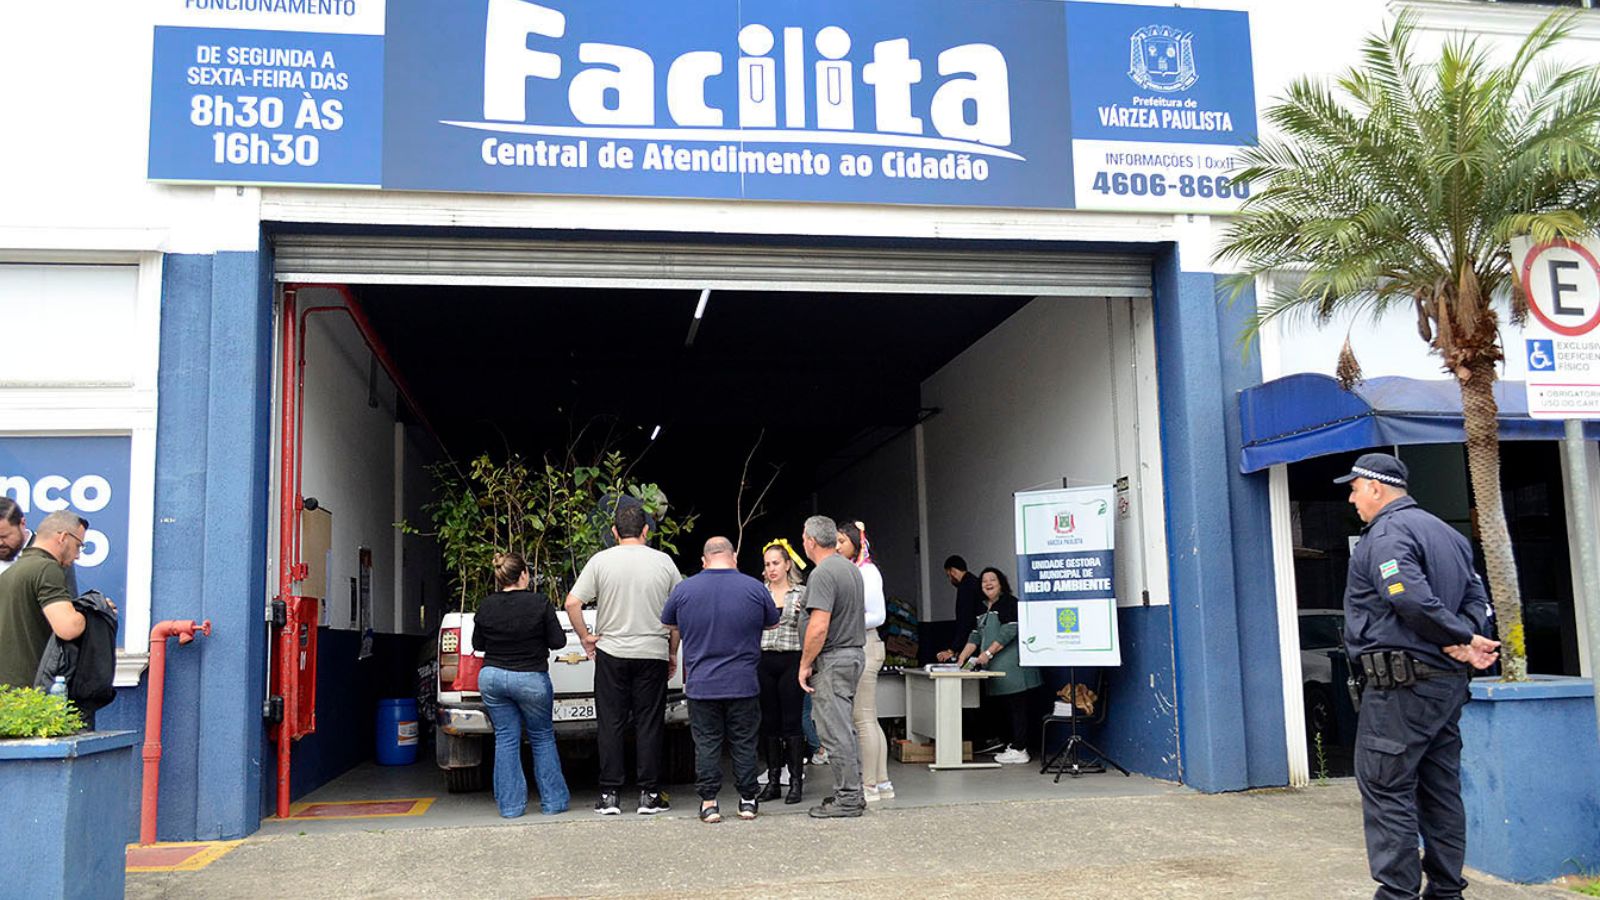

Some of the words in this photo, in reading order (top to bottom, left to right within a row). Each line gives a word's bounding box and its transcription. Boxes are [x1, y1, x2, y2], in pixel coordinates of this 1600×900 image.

[196, 45, 221, 64] DE
[227, 47, 316, 68] SEGUNDA
[321, 51, 336, 69] A
[187, 66, 305, 89] SEXTA-FEIRA
[310, 71, 349, 91] DAS
[484, 0, 1012, 147] Facilita
[190, 94, 284, 128] 8h30
[294, 91, 344, 131] ÀS
[1132, 96, 1183, 108] Prefeitura
[1184, 97, 1197, 108] de
[1098, 104, 1160, 129] VÁRZEA
[1162, 109, 1233, 132] PAULISTA
[213, 132, 320, 167] 16h30
[481, 137, 588, 168] Central
[598, 142, 634, 169] de
[642, 143, 831, 177] Atendimento
[839, 152, 873, 177] ao
[882, 150, 989, 181] Cidadão
[1105, 152, 1194, 170] INFORMAÇÕES
[1092, 171, 1250, 200] 4606-8660
[1548, 260, 1585, 316] E
[1031, 559, 1064, 570] UNIDADE
[1066, 557, 1101, 568] GESTORA
[1039, 569, 1081, 580] MUNICIPAL
[1082, 568, 1093, 578] DE
[1024, 581, 1051, 593] MEIO
[1053, 578, 1111, 592] AMBIENTE
